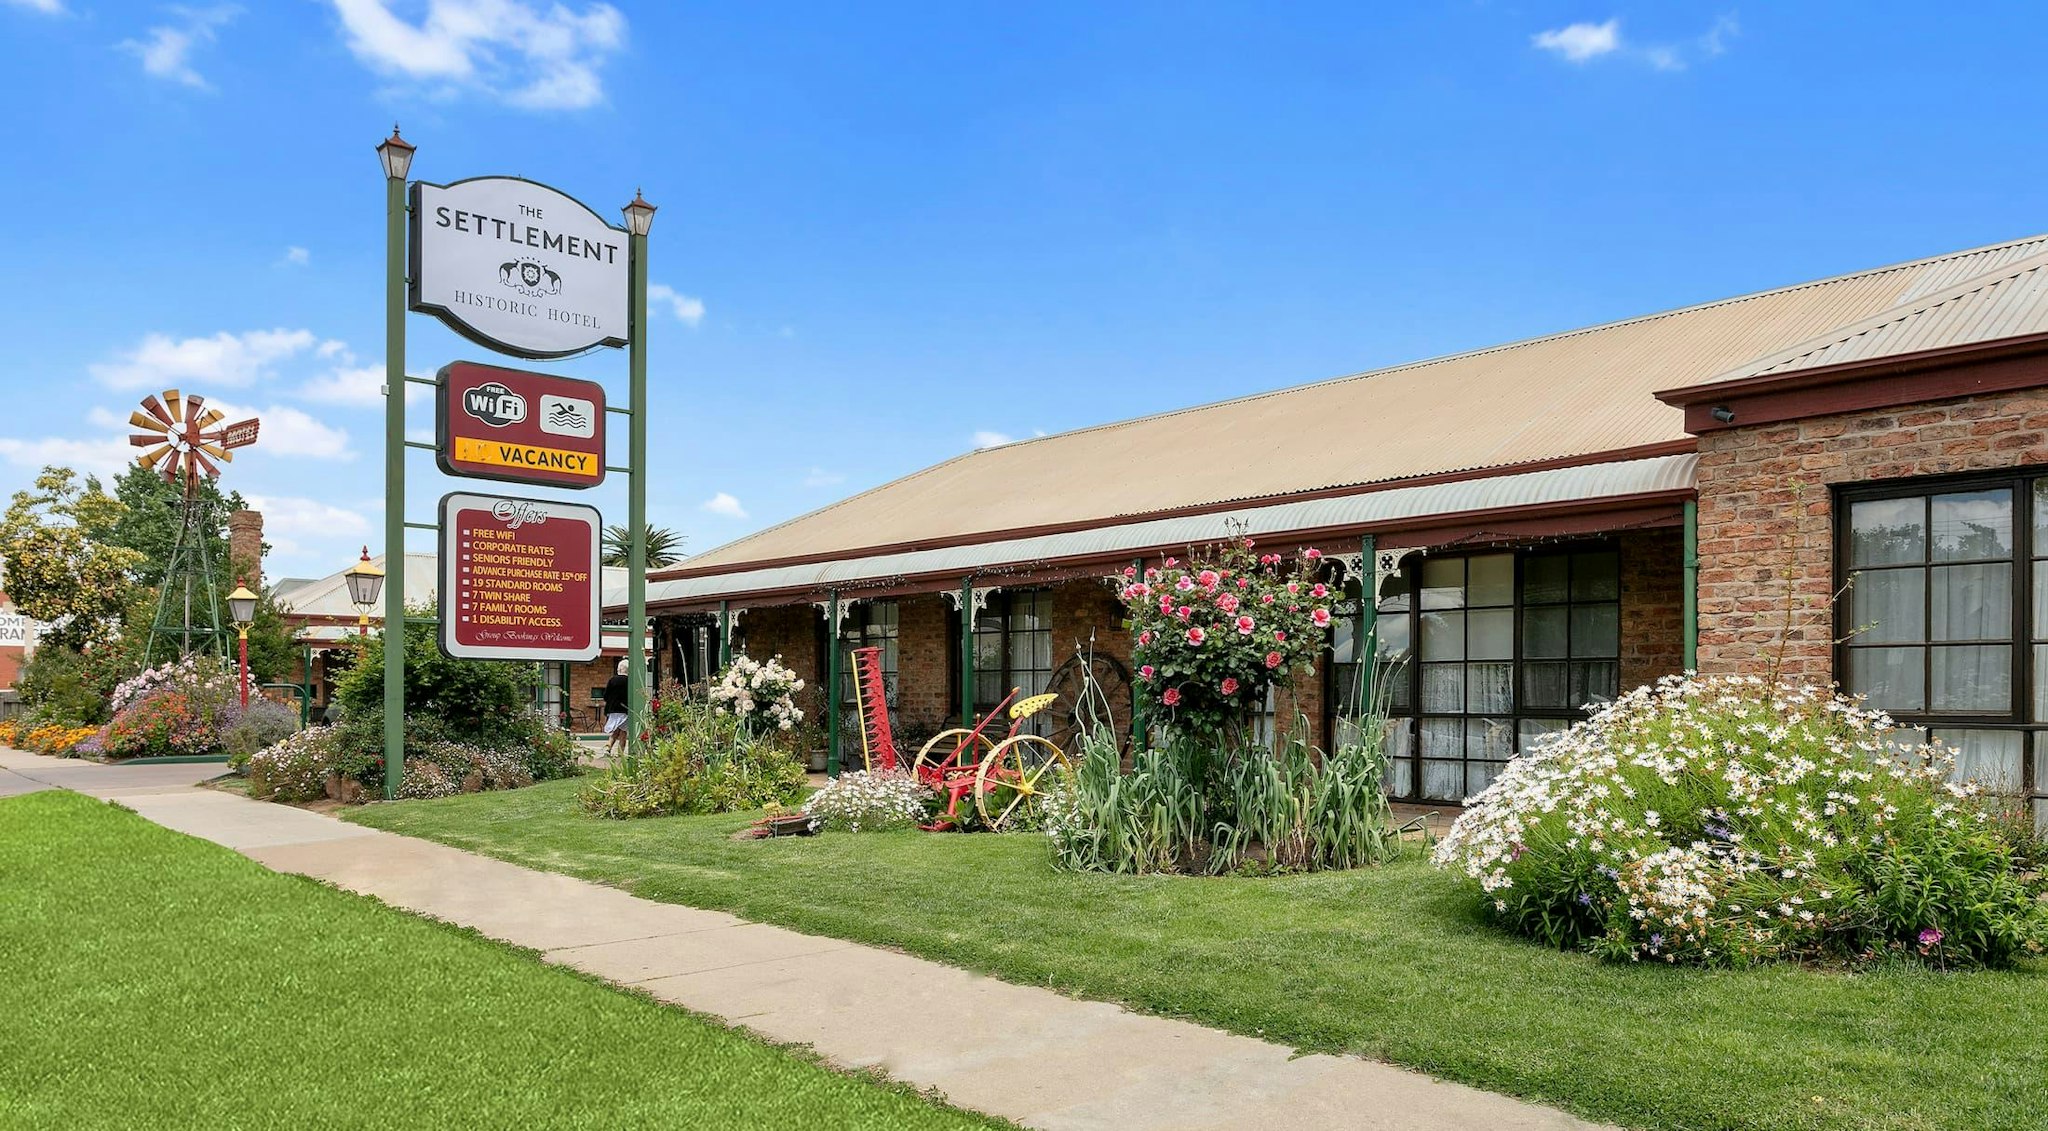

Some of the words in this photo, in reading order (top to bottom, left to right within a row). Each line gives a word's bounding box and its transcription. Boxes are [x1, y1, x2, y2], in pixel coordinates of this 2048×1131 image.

[518, 204, 543, 220] THE
[435, 206, 618, 264] SETTLEMENT
[454, 290, 538, 318] HISTORIC
[548, 308, 601, 330] HOTEL
[486, 386, 506, 394] FREE
[470, 394, 519, 416] WiFi
[499, 446, 588, 471] VACANCY
[492, 500, 549, 530] Offers
[472, 528, 495, 539] FREE
[495, 530, 516, 541] WIFI
[472, 540, 527, 554] CORPORATE
[527, 545, 555, 557] RATES
[472, 553, 511, 565] SENIORS
[511, 556, 554, 568] FRIENDLY
[472, 566, 506, 577] ADVANCE
[506, 568, 543, 579] PURCHASE
[543, 570, 560, 580] RATE
[574, 572, 588, 582] OFF
[472, 578, 484, 588] 19
[485, 579, 532, 591] STANDARD
[532, 582, 563, 593] ROOMS
[472, 590, 479, 600] 7
[479, 590, 502, 601] TWIN
[503, 592, 531, 603] SHARE
[472, 602, 479, 612] 7
[479, 602, 514, 613] FAMILY
[514, 604, 548, 615] ROOMS
[472, 614, 478, 624] 1
[479, 614, 527, 626] DISABILITY
[527, 617, 563, 628] ACCESS.
